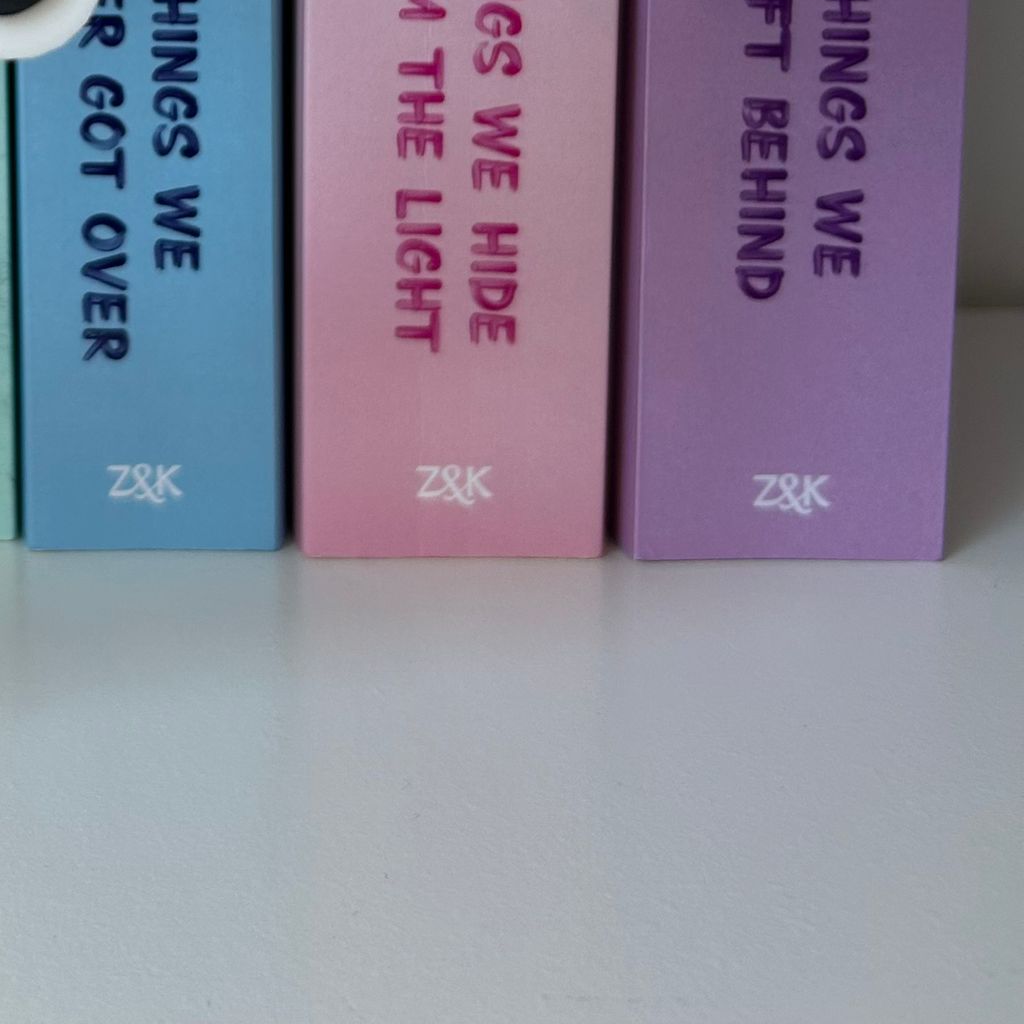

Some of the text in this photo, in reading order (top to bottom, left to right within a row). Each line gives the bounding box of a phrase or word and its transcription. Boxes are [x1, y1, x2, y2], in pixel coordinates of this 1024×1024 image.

[79, 74, 127, 190] GOT
[395, 47, 446, 160] THE
[471, 104, 522, 192] WE
[153, 185, 202, 272] WE
[734, 96, 791, 301] BEHIND
[812, 188, 865, 279] WE
[80, 212, 130, 362] OVER
[394, 189, 443, 353] LIGHT
[468, 222, 520, 346] HIDE
[106, 464, 183, 502] Z&K
[415, 464, 494, 506] Z&K
[752, 472, 832, 514] Z&K
